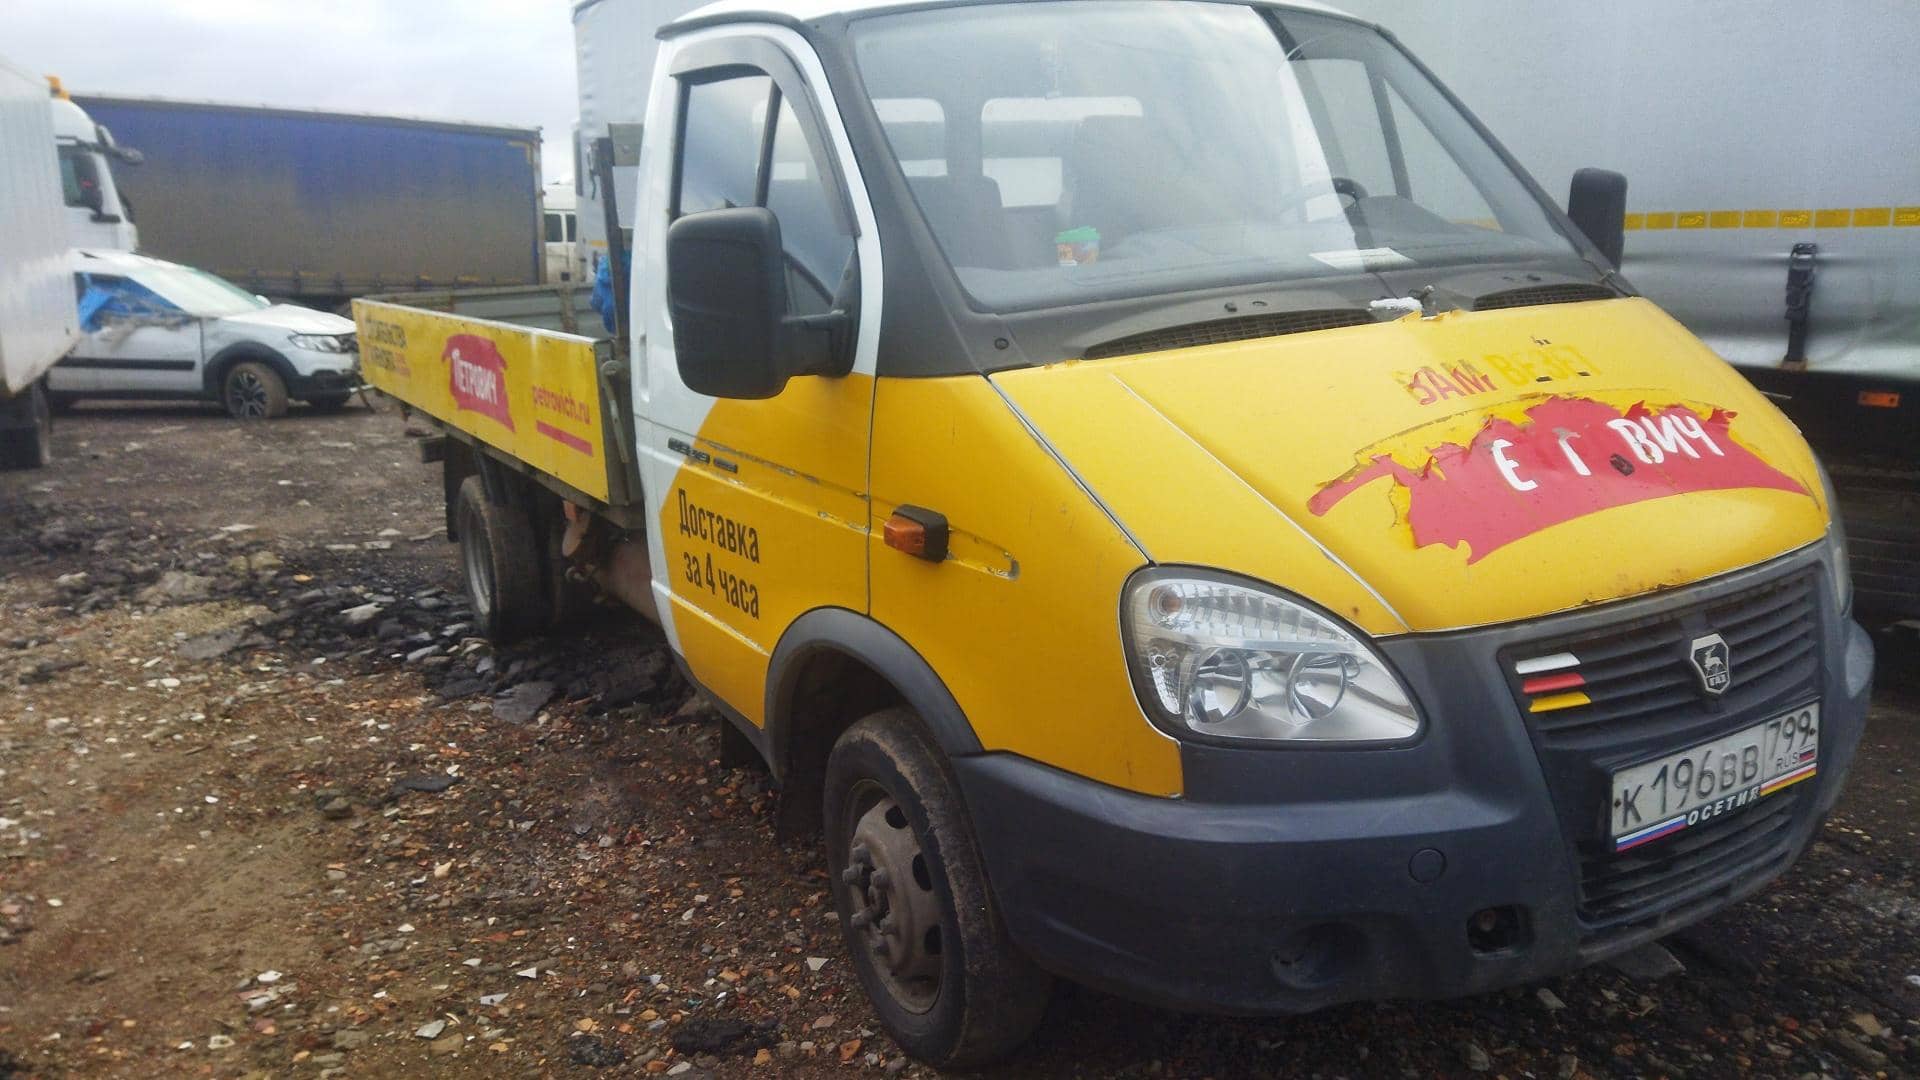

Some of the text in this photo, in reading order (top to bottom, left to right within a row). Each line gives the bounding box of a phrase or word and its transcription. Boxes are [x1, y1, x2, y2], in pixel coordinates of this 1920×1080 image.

[678, 487, 761, 564] Доставка
[683, 551, 760, 620] за 4 часа
[1766, 709, 1814, 761] 799
[1775, 751, 1801, 772] RUS
